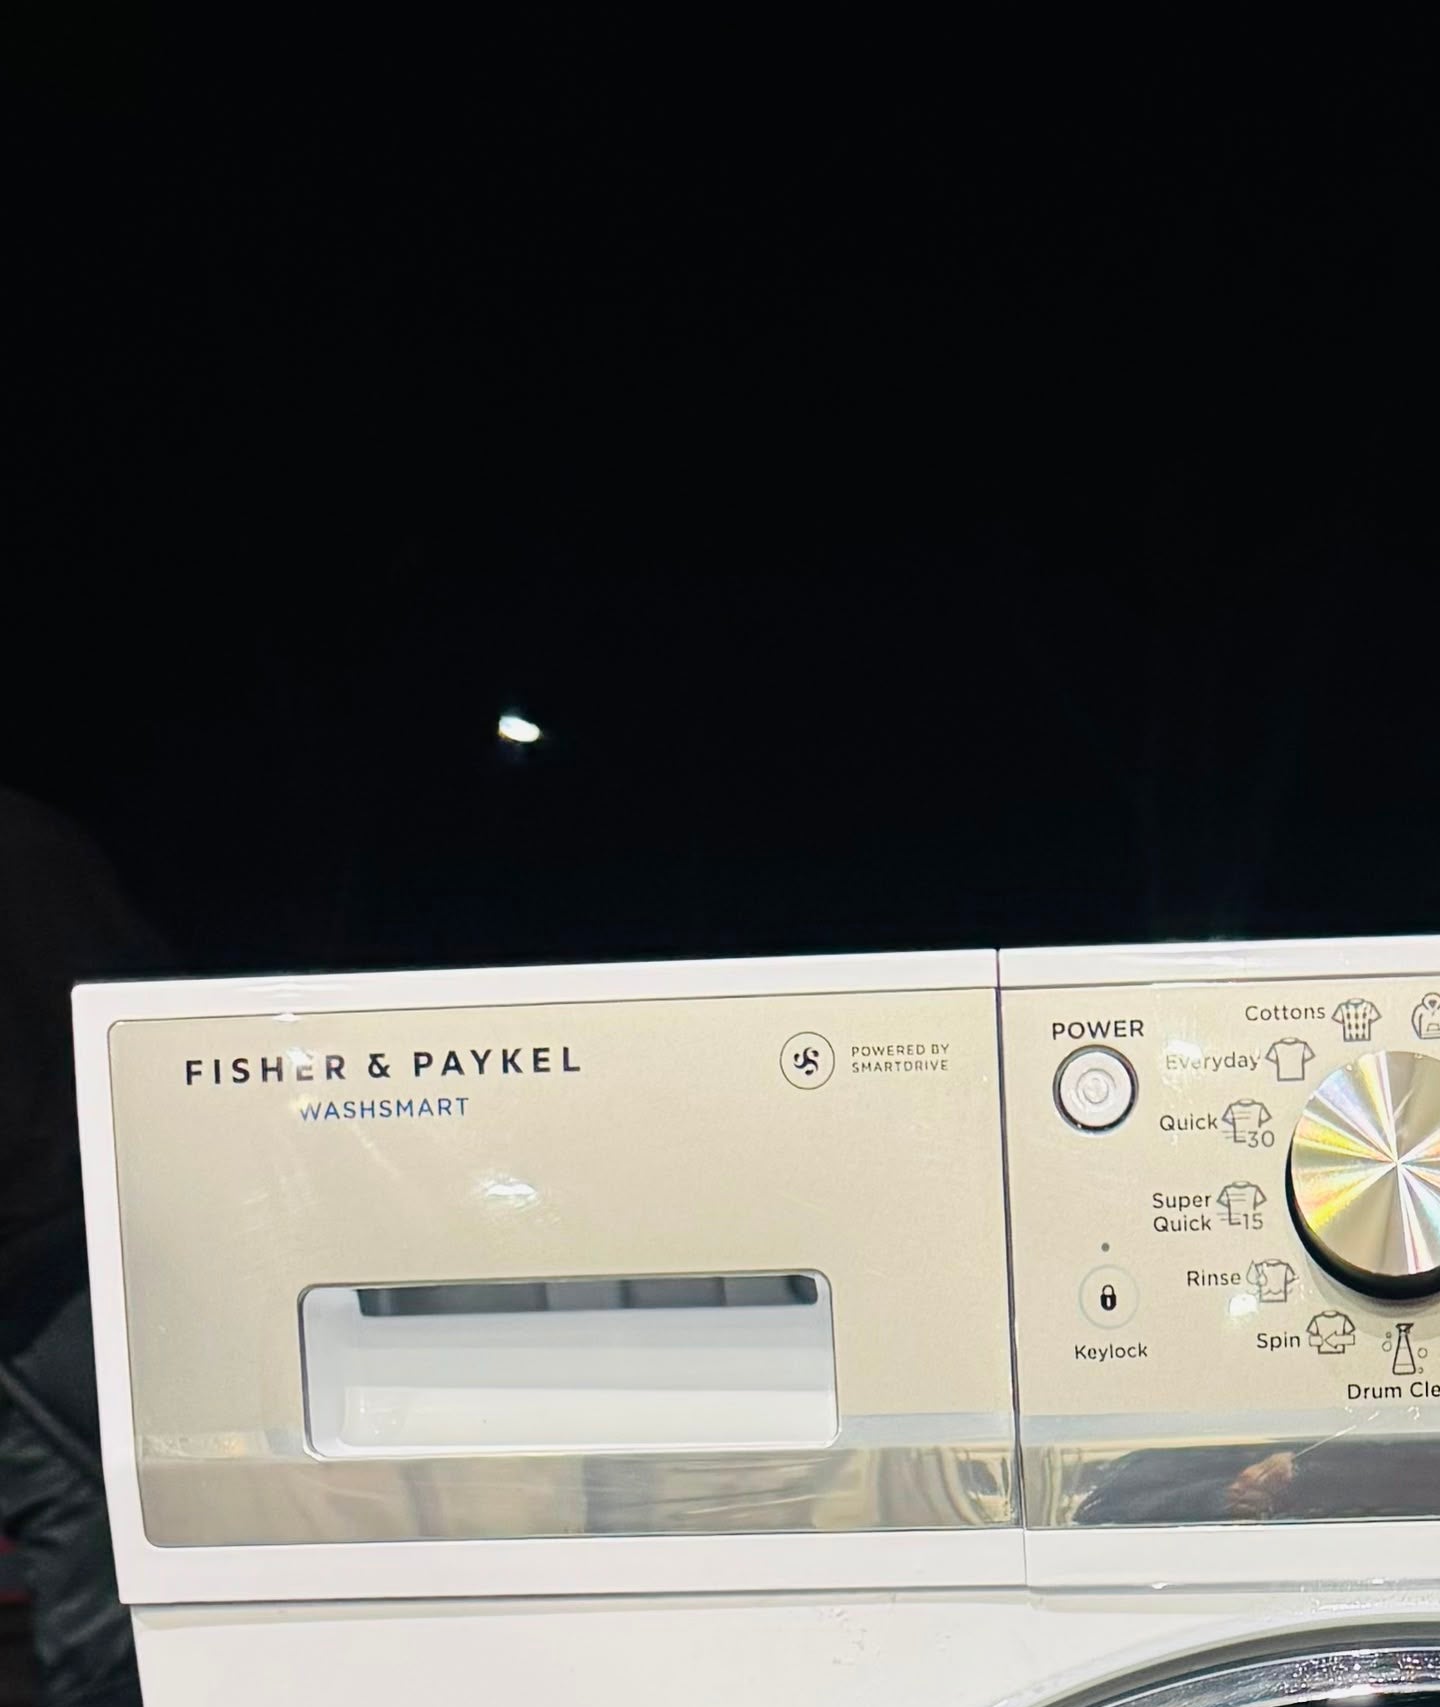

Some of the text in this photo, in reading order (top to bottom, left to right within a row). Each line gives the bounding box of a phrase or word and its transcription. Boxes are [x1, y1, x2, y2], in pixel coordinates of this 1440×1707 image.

[1245, 1004, 1326, 1021] Cottons
[1052, 1020, 1144, 1039] POWER
[851, 1043, 950, 1057] POWERED BY
[186, 1046, 581, 1086] FISHER & PAYKEL
[852, 1059, 949, 1074] SMARTDRIVE
[1166, 1051, 1259, 1072] Everyday
[300, 1097, 469, 1121] WASHSMART
[1160, 1113, 1218, 1132] Quick
[1248, 1129, 1274, 1148] 30
[1153, 1191, 1210, 1212] Super
[1154, 1214, 1211, 1233] Quick
[1242, 1213, 1263, 1230] 15
[1188, 1269, 1240, 1285] Rinse
[1074, 1342, 1148, 1360] Keylock
[1257, 1331, 1300, 1352] Spin
[1348, 1382, 1402, 1400] Drum
